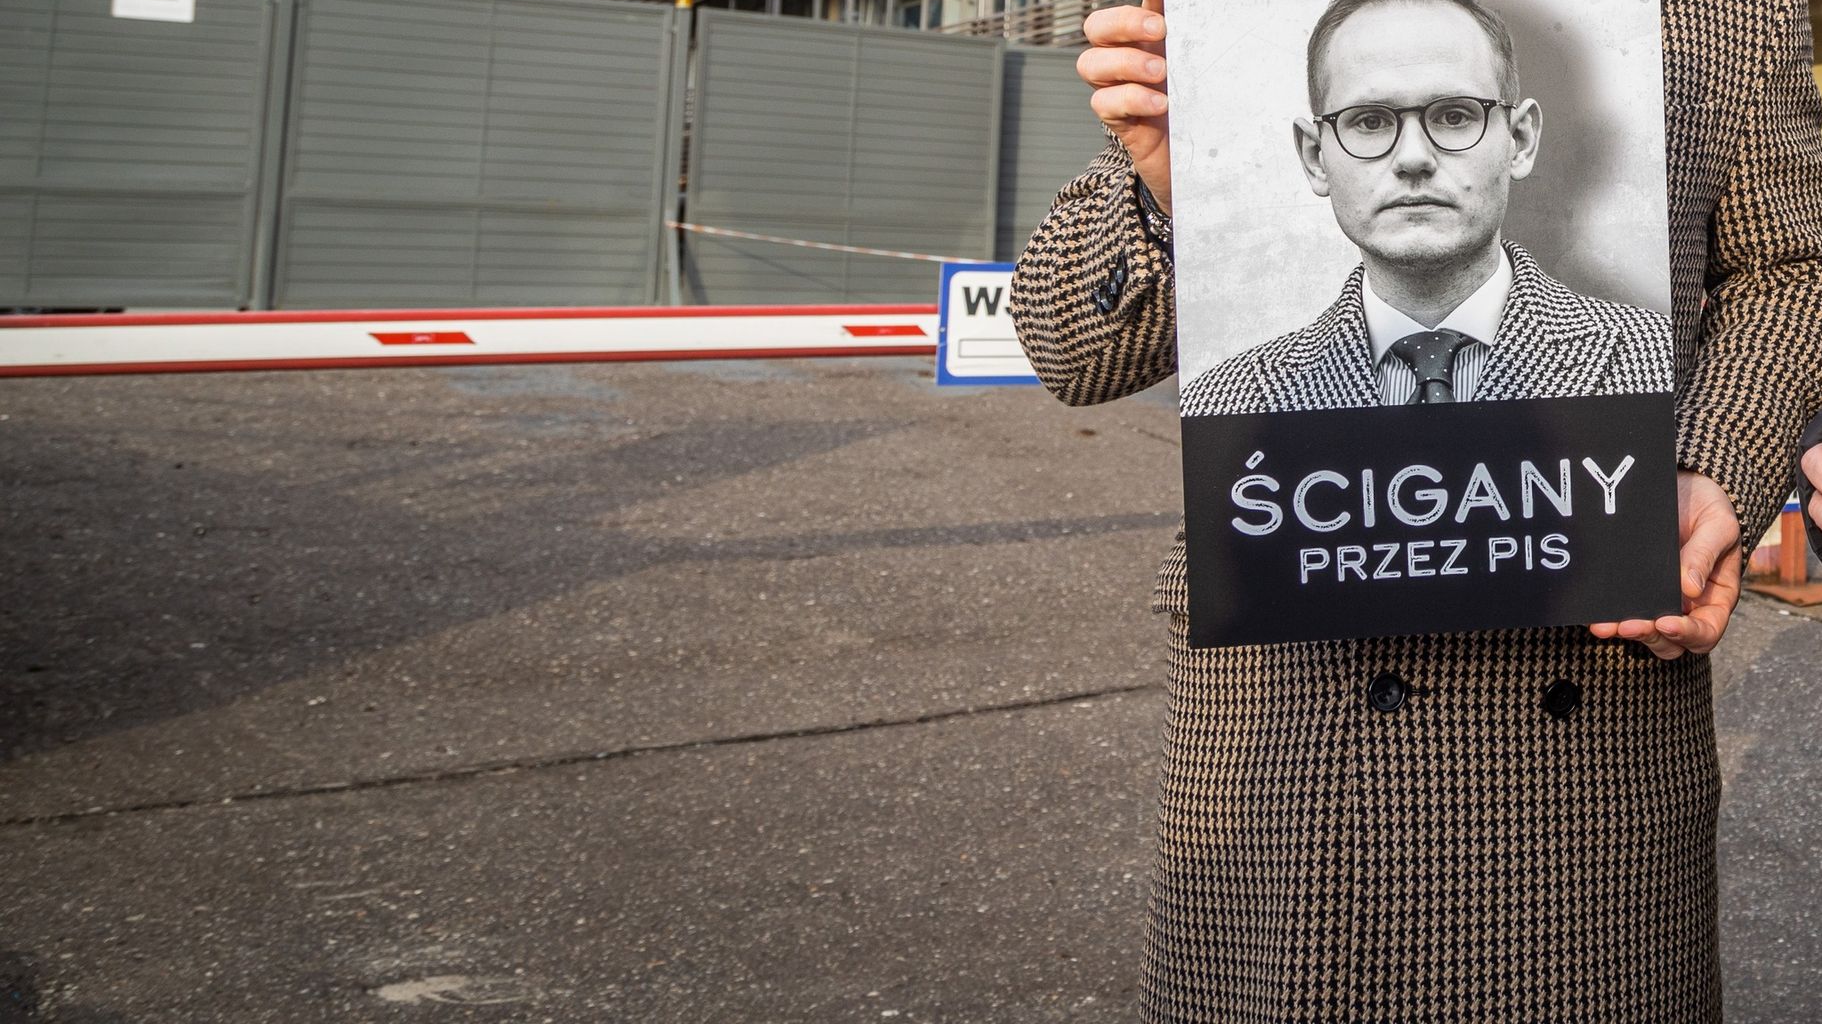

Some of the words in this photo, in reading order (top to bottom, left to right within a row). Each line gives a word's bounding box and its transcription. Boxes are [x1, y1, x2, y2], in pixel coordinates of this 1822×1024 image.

[1231, 450, 1635, 536] ŚCIGANY
[1301, 539, 1468, 584] PRZEZ
[1488, 533, 1571, 572] PIS
